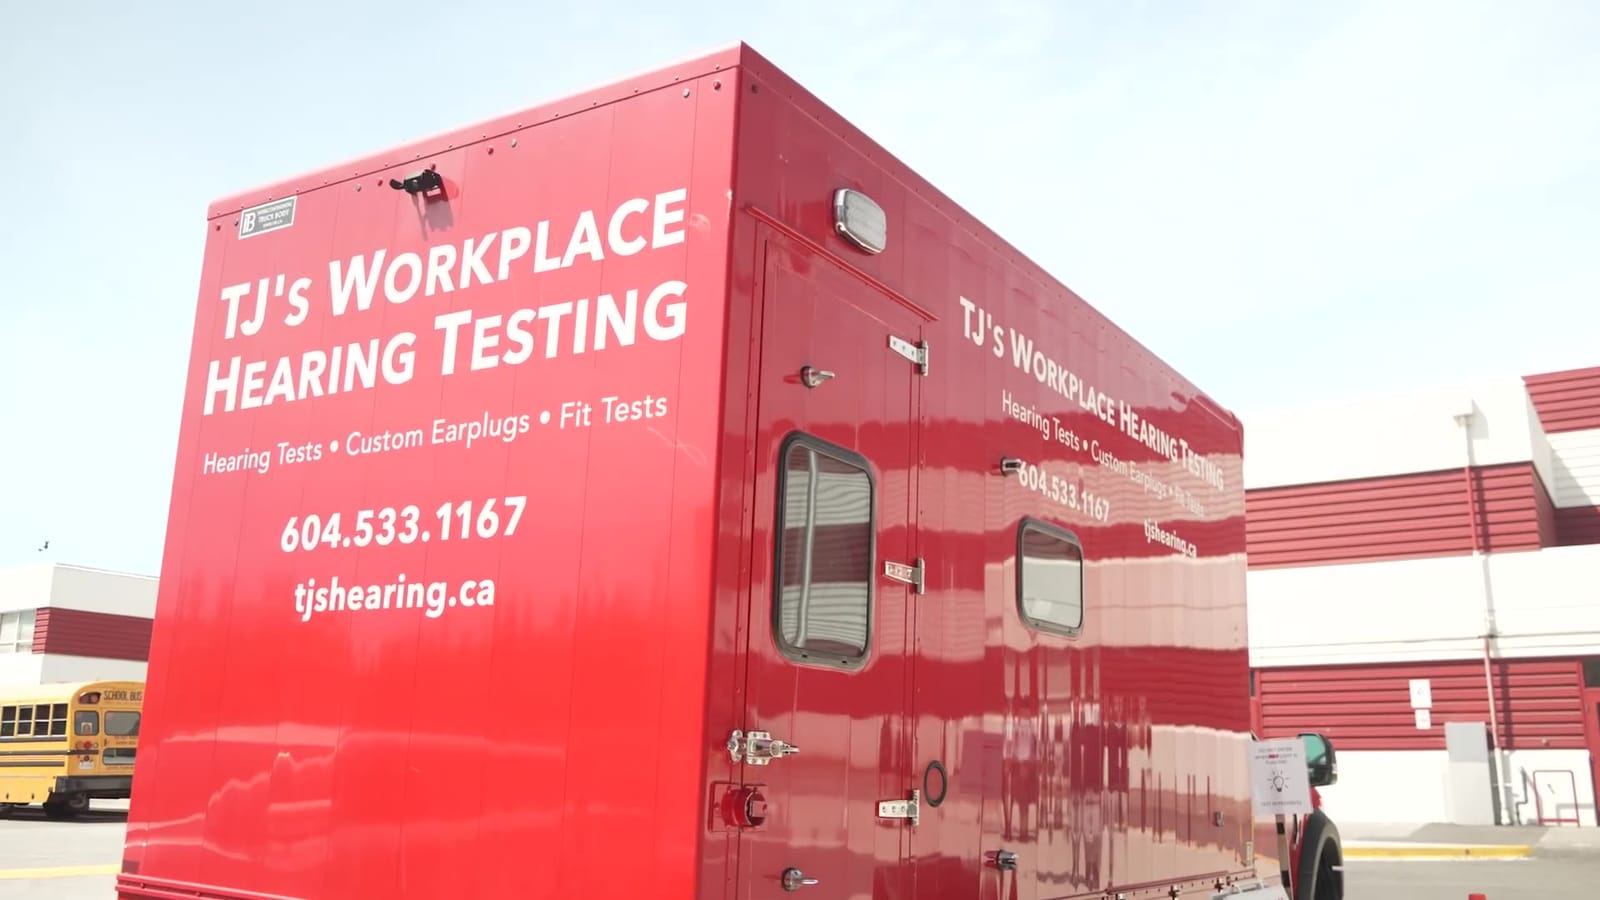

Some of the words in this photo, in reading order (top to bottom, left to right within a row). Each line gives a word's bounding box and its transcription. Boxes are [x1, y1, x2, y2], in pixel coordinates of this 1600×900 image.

[203, 448, 271, 475] Hearing
[277, 441, 323, 466] Tests
[345, 429, 424, 457] Custom
[431, 411, 531, 449] Earplugs
[559, 401, 593, 430] Fit
[600, 394, 669, 424] Tests
[1002, 389, 1050, 441] Hearing
[1052, 416, 1081, 452] Tests
[1091, 440, 1128, 477] Custom
[1129, 460, 1168, 501] Earplugs
[1018, 461, 1110, 523] 604.533.1167
[280, 496, 528, 553] 604.533.1167
[1144, 518, 1198, 559] tjshearing.ca
[294, 573, 496, 622] tjshearing.ca
[103, 690, 128, 701] SCHOOL
